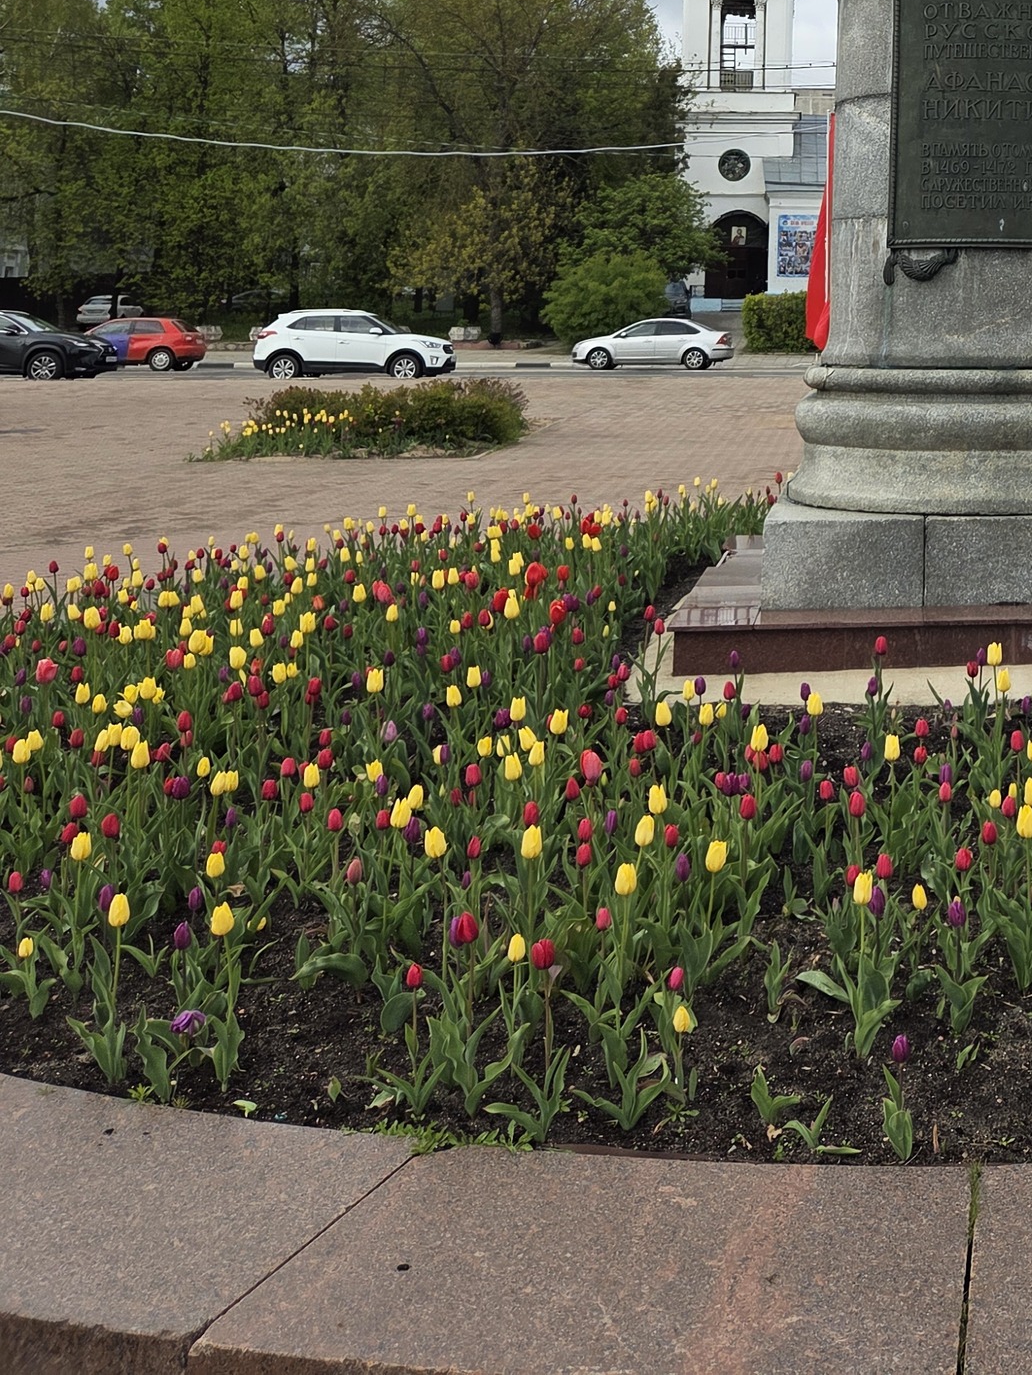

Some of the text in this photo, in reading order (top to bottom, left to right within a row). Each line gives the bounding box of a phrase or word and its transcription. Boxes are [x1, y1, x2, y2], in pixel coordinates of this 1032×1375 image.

[921, 142, 930, 158] В
[932, 142, 989, 158] ПАМЯТЬ
[921, 160, 930, 175] В
[921, 178, 929, 193] С
[921, 194, 1006, 210] ПОСЕТИЛ
